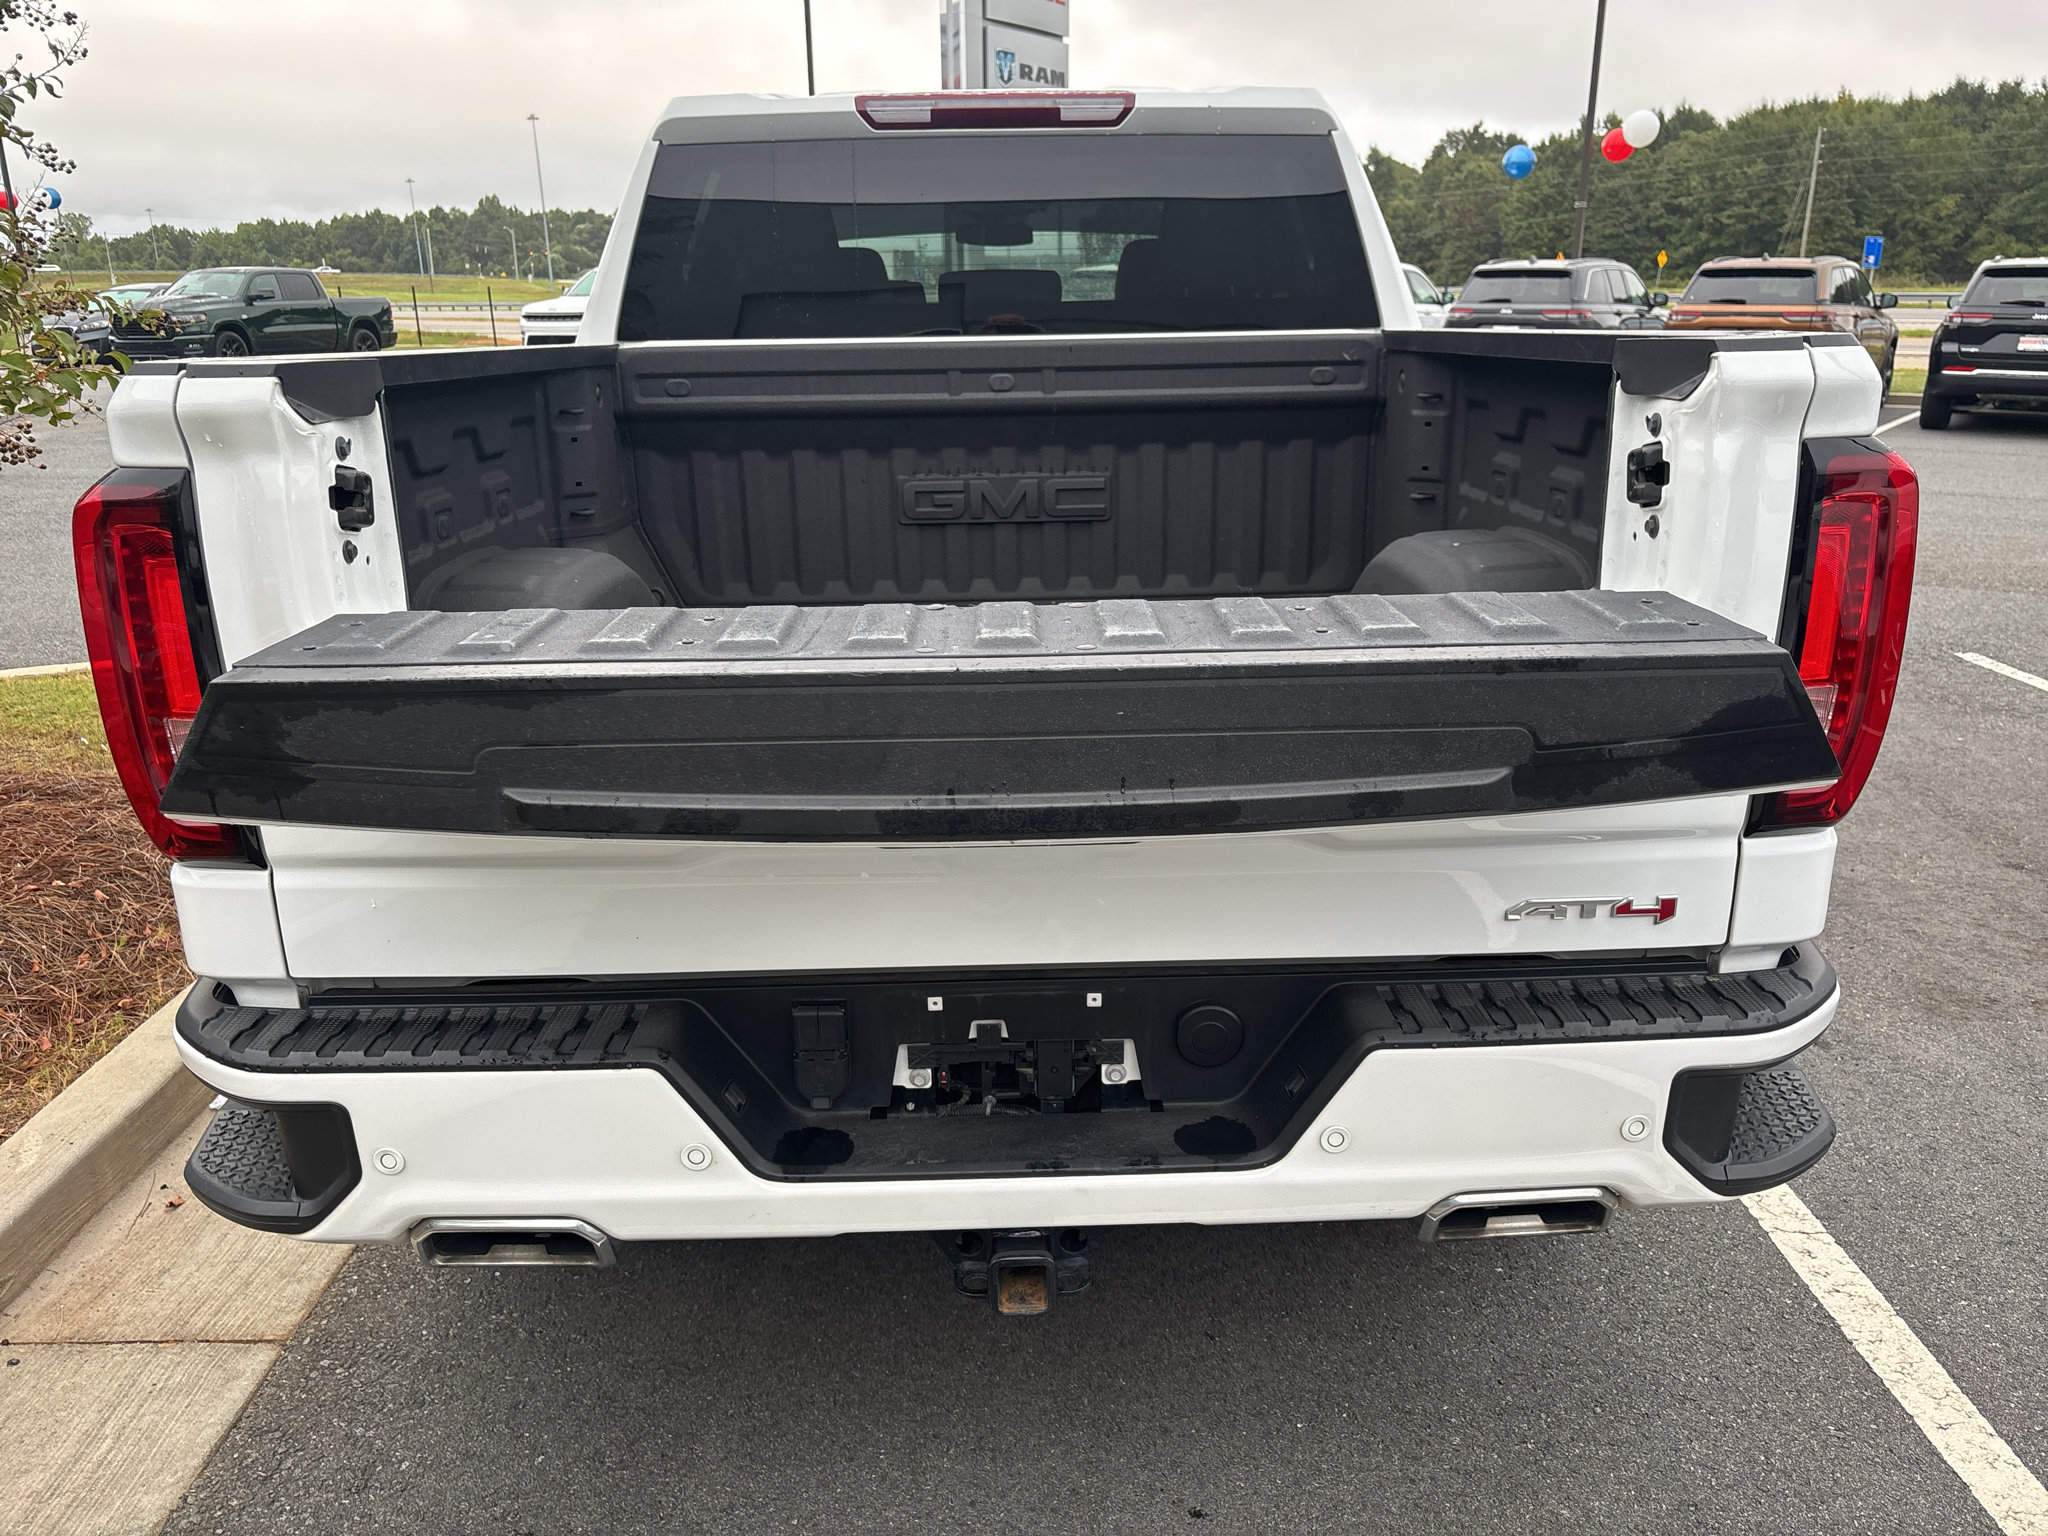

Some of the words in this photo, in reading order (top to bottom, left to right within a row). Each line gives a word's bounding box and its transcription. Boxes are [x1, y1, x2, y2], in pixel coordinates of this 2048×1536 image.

[1019, 63, 1065, 88] RAM
[903, 477, 1107, 520] GMC
[1504, 893, 1679, 926] AT4
